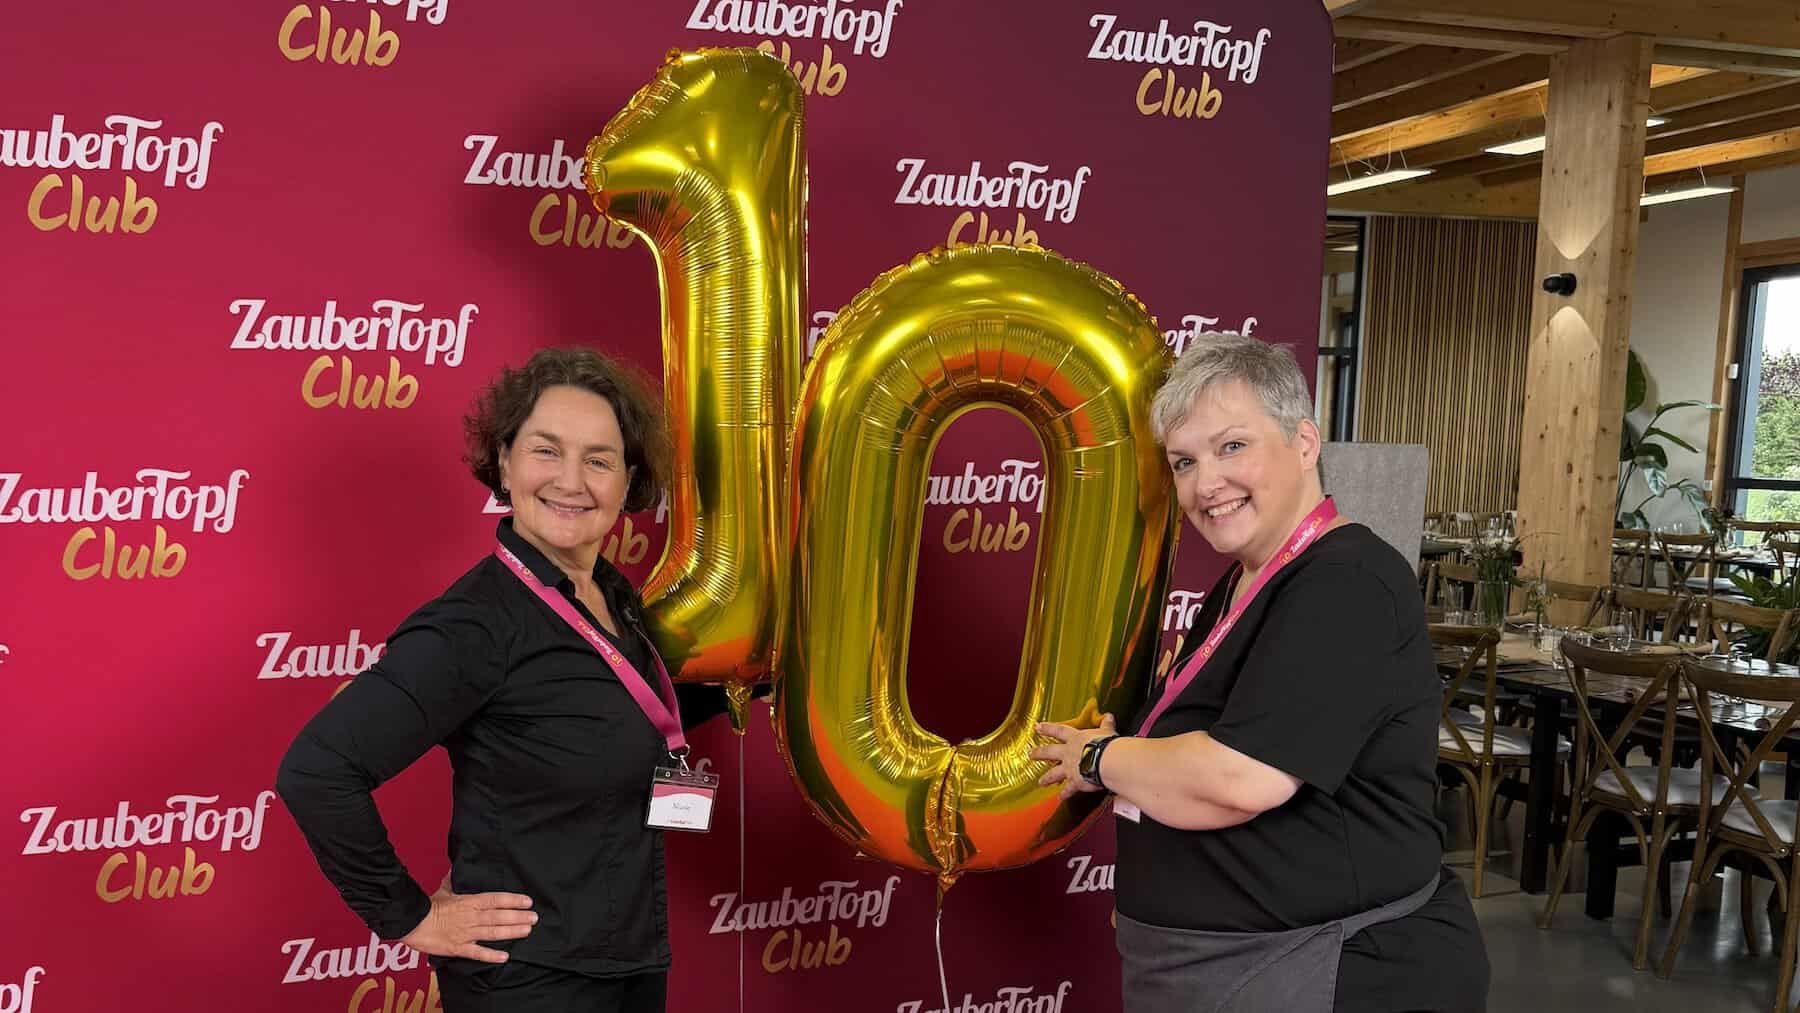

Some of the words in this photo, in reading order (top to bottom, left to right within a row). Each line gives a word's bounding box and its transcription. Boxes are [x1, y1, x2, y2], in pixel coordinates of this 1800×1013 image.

[278, 4, 400, 66] Club
[1088, 14, 1271, 84] ZauberTopf
[756, 40, 848, 96] lub
[1136, 68, 1223, 119] Club
[28, 174, 158, 233] Club
[895, 158, 1091, 224] ZauberTopf
[229, 299, 479, 367] ZauberTopf
[302, 355, 418, 408] Club
[0, 468, 250, 533] ZauberTopf
[943, 506, 1031, 553] Club
[62, 525, 187, 580] Club
[20, 791, 276, 855] ZauberTopf
[96, 848, 215, 902] Club
[708, 876, 900, 934] ZauberTopf
[761, 925, 853, 973] Club
